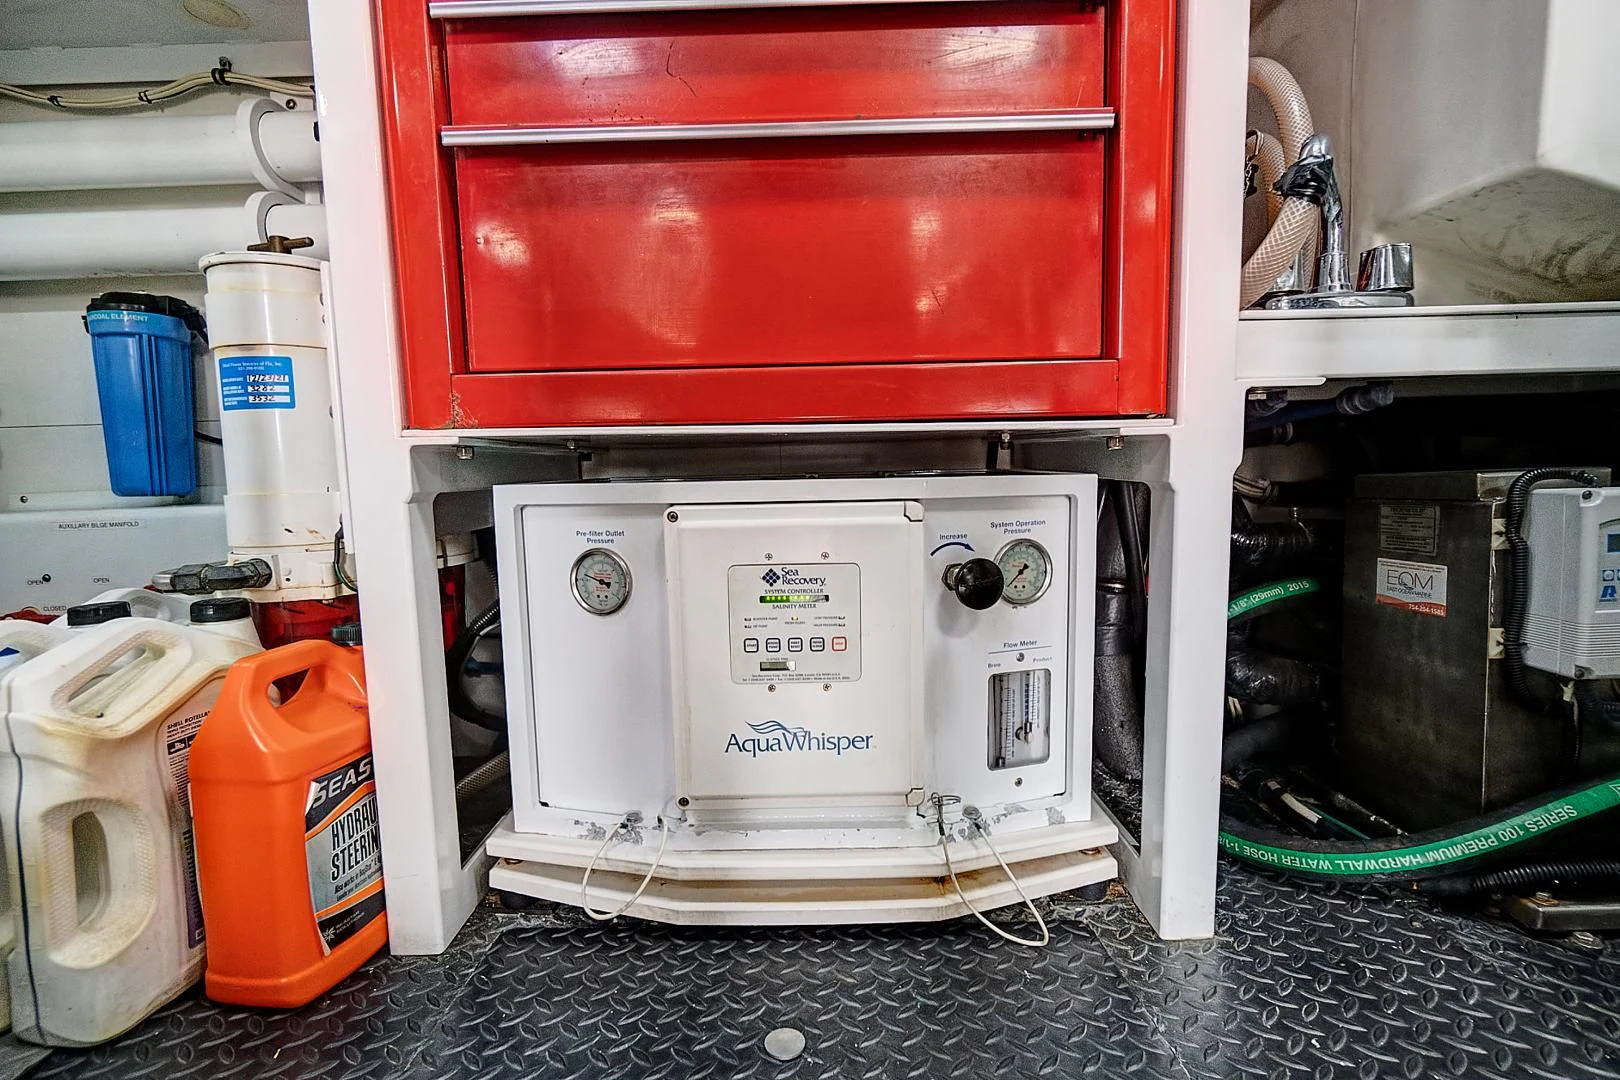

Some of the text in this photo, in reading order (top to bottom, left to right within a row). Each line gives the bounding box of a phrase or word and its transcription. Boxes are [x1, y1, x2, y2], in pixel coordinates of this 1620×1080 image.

[111, 313, 148, 321] ELEMENT
[990, 519, 1046, 529] System Operation
[781, 567, 799, 577] Sea
[781, 577, 826, 587] Recovery
[1249, 586, 1284, 604] (29mm)
[1287, 581, 1310, 592] 2015
[167, 720, 183, 730] SHELL
[725, 730, 874, 758] AquaWhisper
[313, 756, 372, 809] SEAS
[331, 796, 377, 851] HYDRAU
[1526, 805, 1578, 833] SERIES
[1499, 826, 1525, 842] 100
[331, 826, 380, 881] STEERIN
[1243, 845, 1278, 863] HOSE
[1425, 834, 1499, 862] PREMIUM
[1281, 855, 1333, 870] WATER
[1335, 853, 1423, 871] HARDWALL
